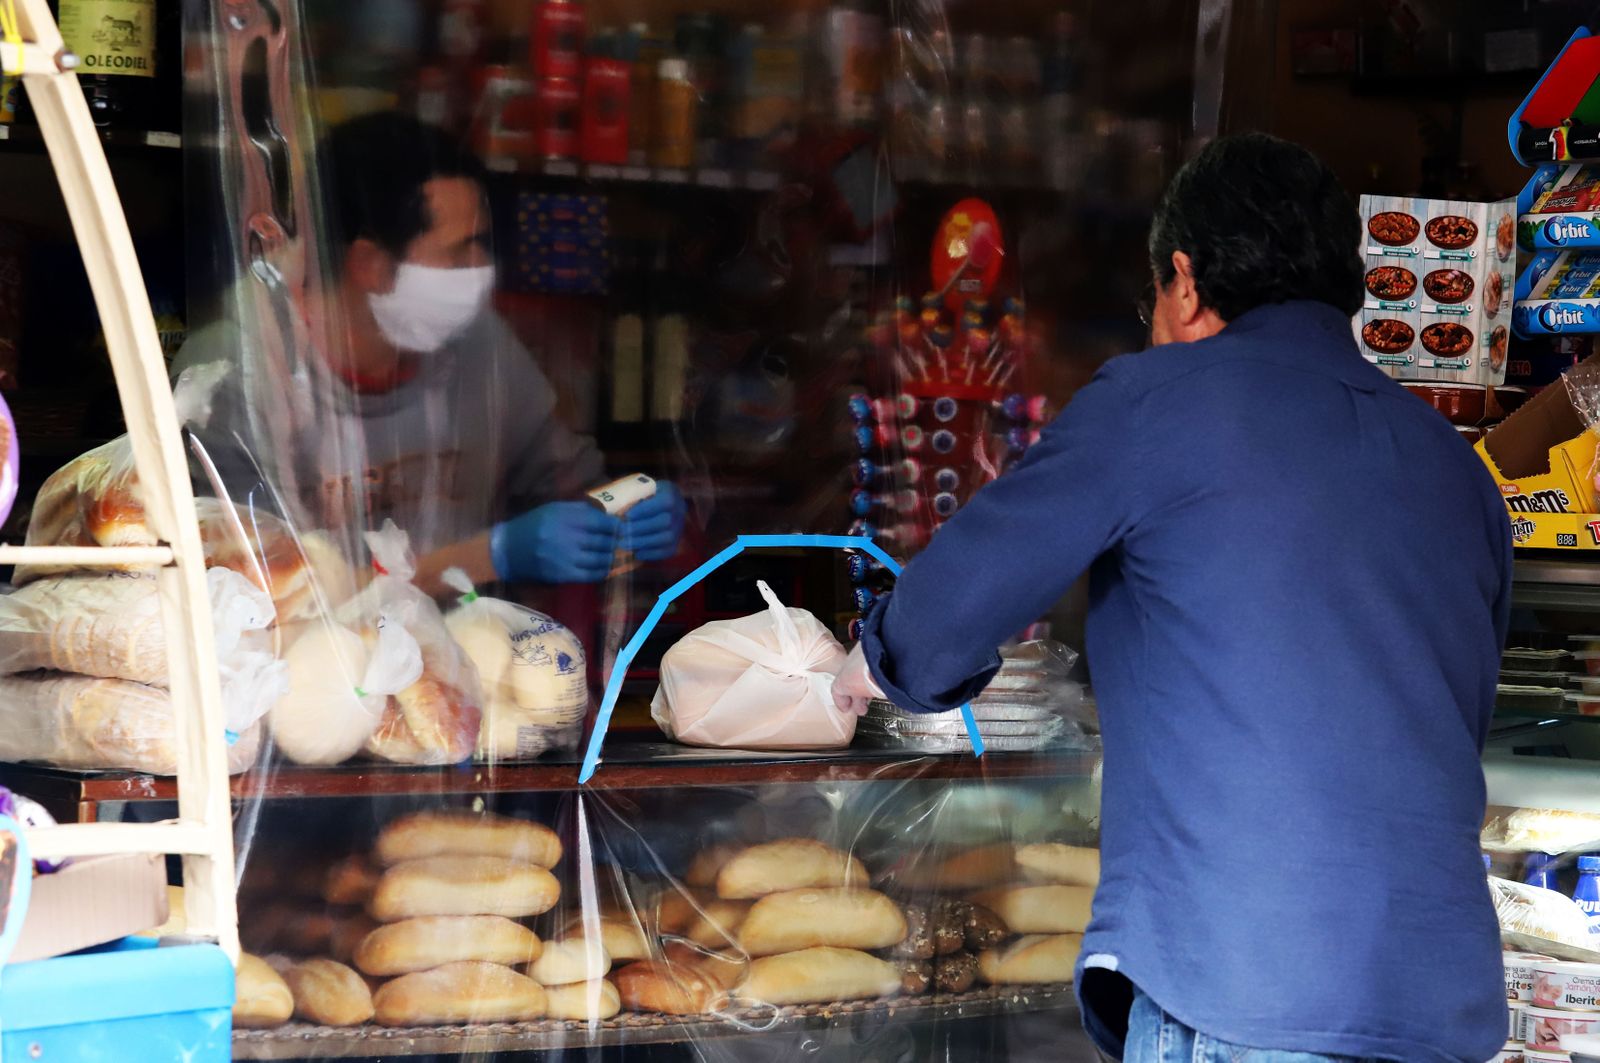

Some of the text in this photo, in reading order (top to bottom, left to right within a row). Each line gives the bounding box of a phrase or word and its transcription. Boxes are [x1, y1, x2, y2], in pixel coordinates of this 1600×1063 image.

[85, 54, 148, 70] OLEODIEL
[1544, 217, 1591, 246] Orbit
[1539, 305, 1585, 331] Orbit
